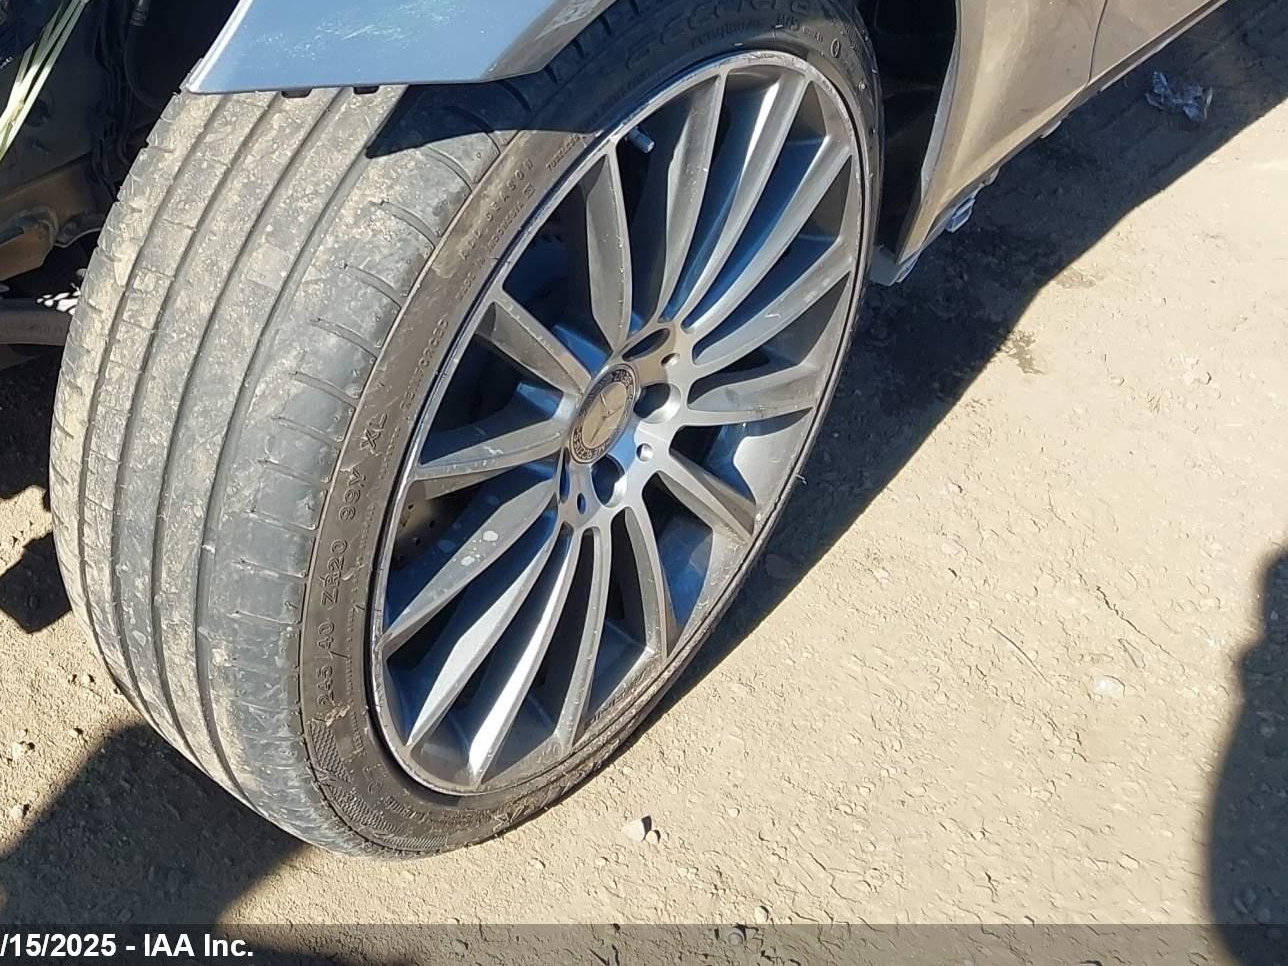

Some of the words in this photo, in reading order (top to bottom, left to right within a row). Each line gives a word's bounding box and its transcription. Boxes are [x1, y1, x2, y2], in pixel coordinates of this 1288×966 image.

[459, 228, 482, 261] ALL
[484, 157, 534, 222] SEASON
[320, 539, 349, 607] ZR20
[360, 412, 388, 450] XL
